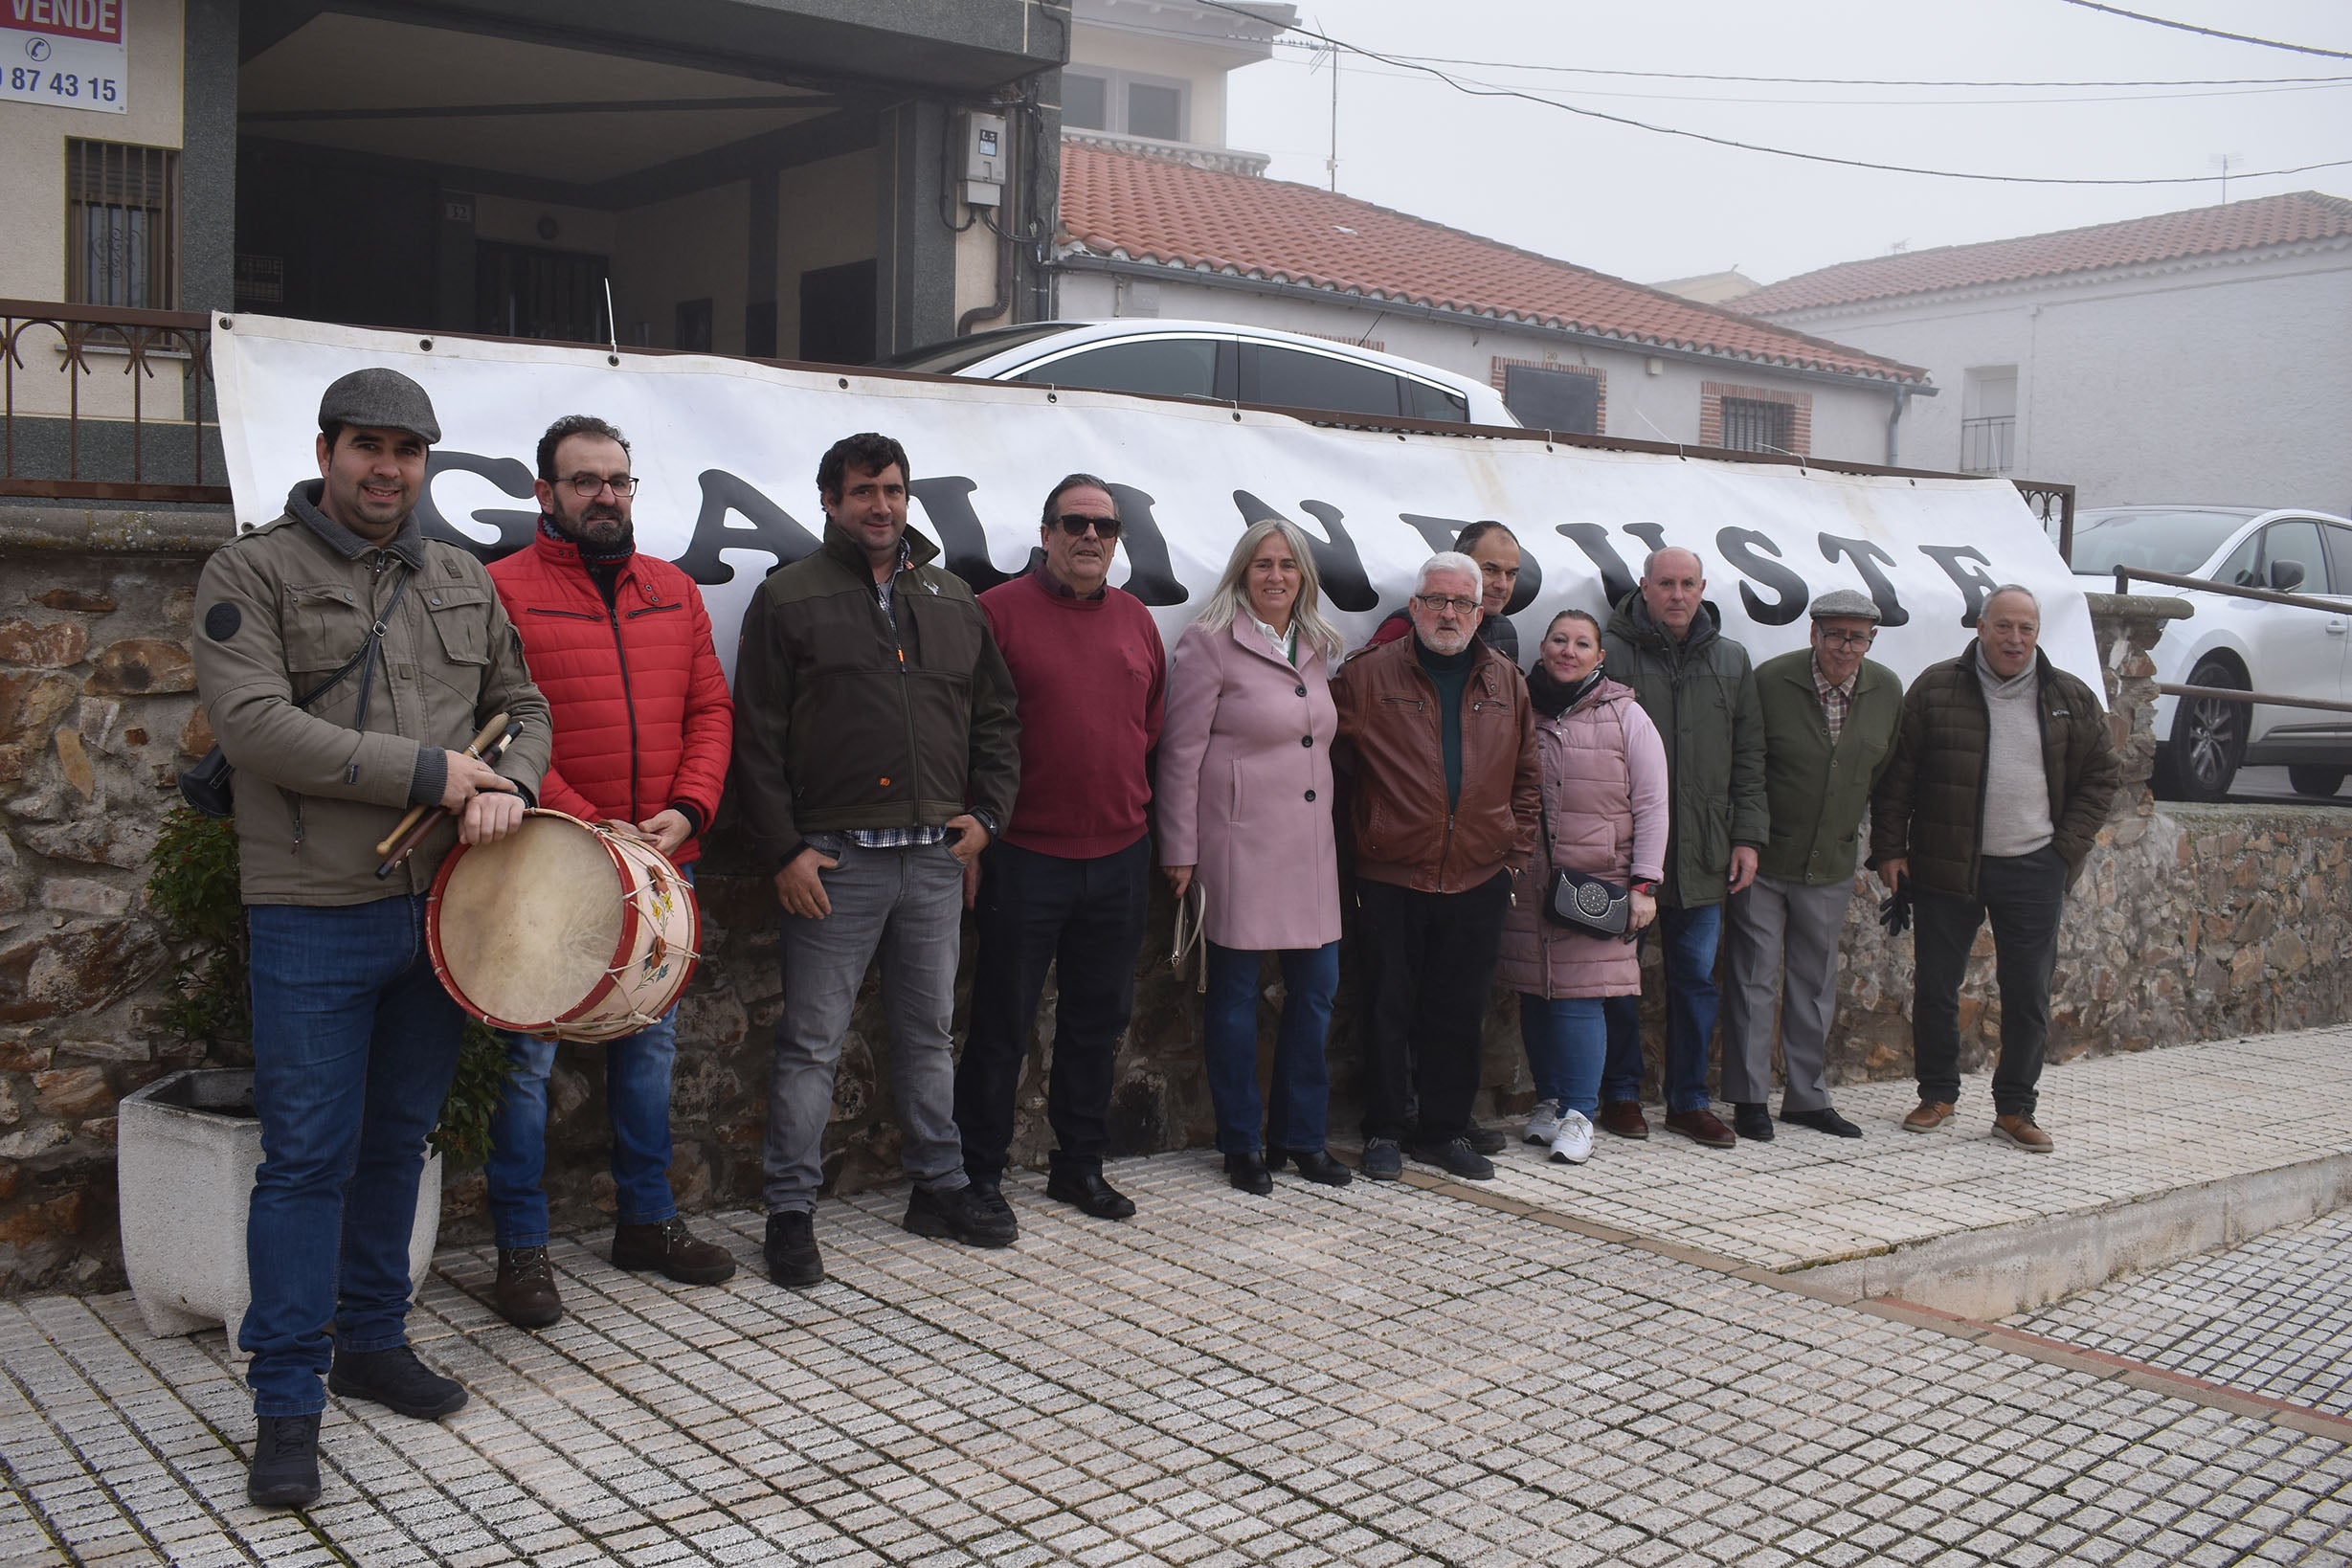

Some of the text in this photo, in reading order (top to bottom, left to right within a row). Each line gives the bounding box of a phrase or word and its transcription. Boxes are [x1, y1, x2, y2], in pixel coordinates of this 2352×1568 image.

[11, 0, 116, 34] VENDE
[11, 67, 41, 92] 87
[49, 73, 78, 98] 43
[87, 77, 117, 102] 15
